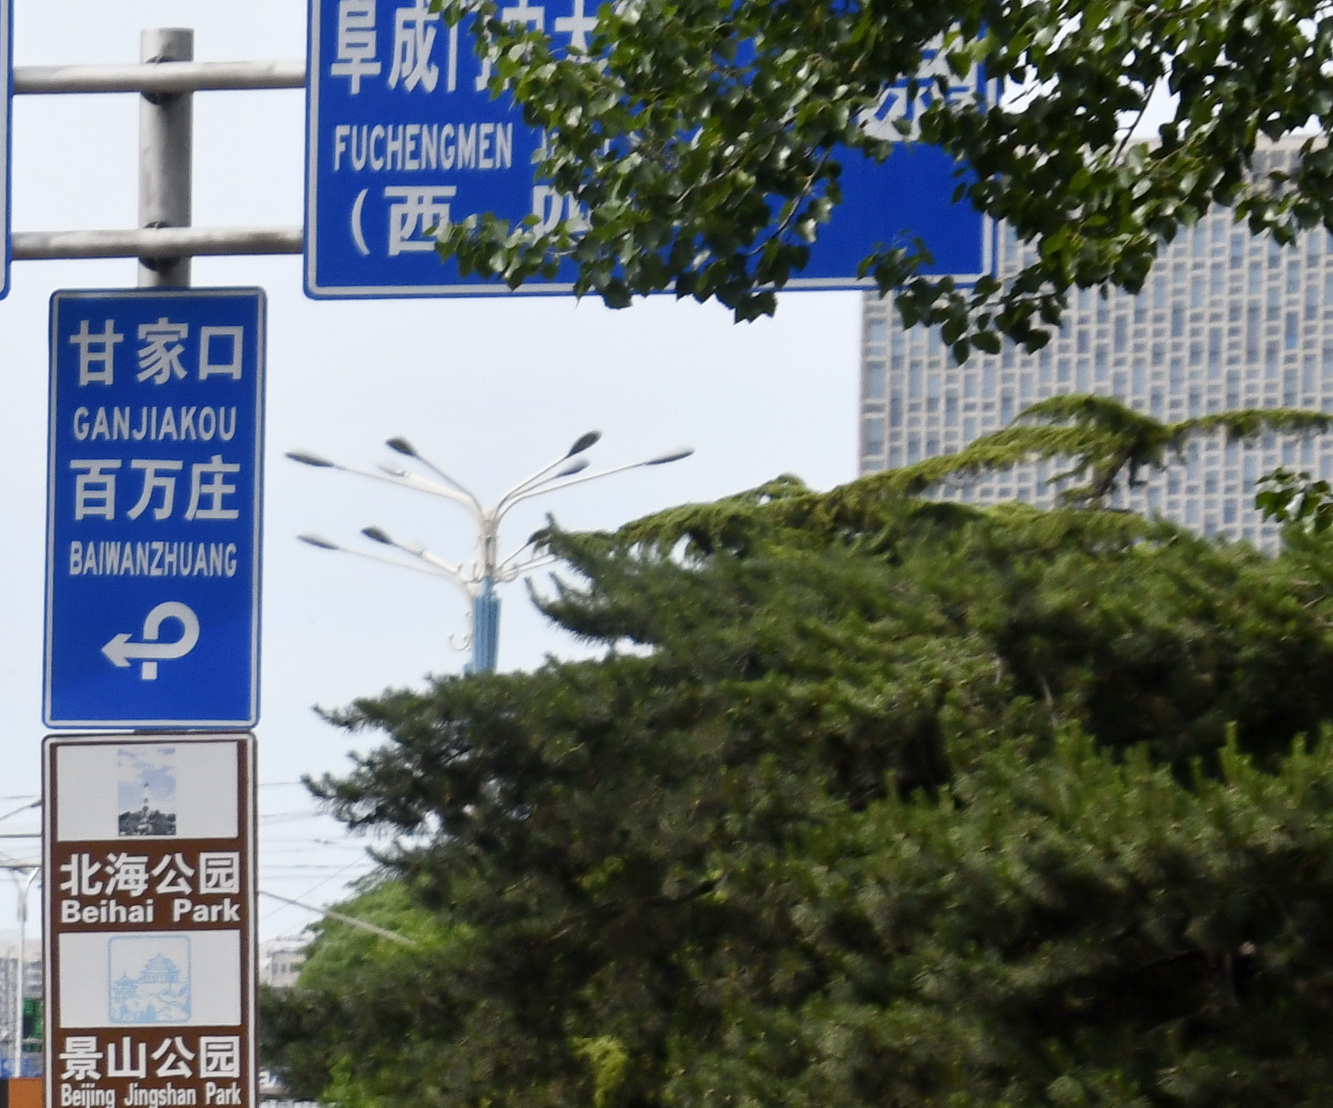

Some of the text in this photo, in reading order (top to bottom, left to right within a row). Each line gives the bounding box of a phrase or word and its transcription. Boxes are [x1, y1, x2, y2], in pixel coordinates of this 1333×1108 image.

[334, 122, 513, 171] FUCHENGMEN
[69, 317, 246, 387] 甘家口
[73, 406, 237, 441] GANJIAKOU
[69, 455, 240, 521] 百万庄
[69, 541, 238, 578] BAIWANZHUANG
[59, 852, 240, 897] 北海公园
[61, 898, 241, 924] Beihai Park
[59, 1036, 240, 1080] 景山公园
[205, 1081, 241, 1106] Park
